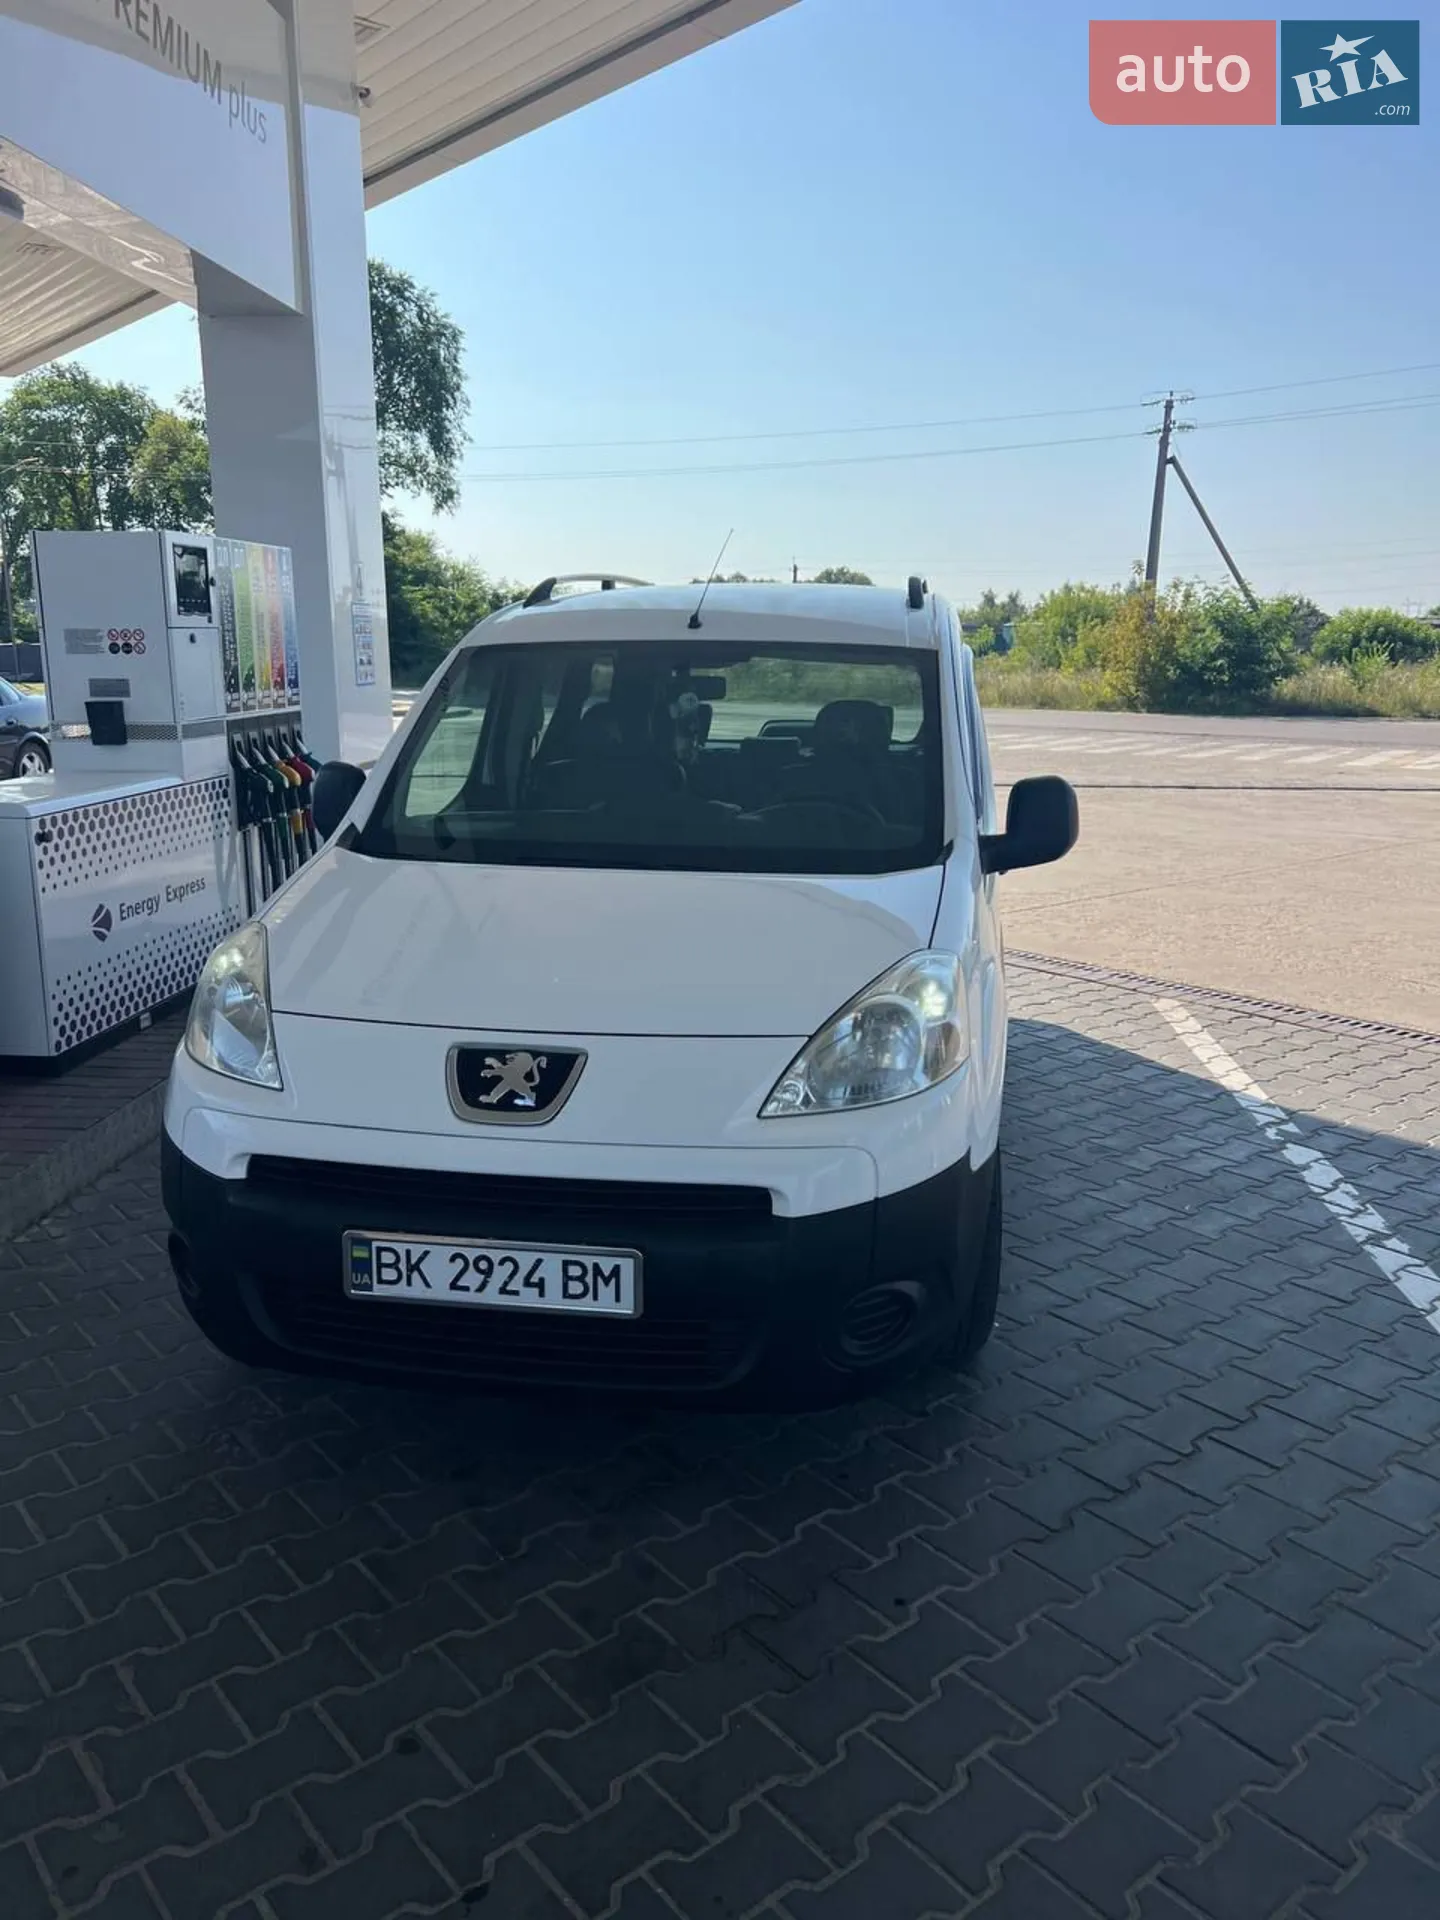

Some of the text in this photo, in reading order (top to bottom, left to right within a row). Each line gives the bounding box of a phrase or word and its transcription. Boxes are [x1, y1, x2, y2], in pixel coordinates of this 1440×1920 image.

[228, 81, 267, 144] plus
[119, 876, 206, 922] Energy Express
[352, 1272, 371, 1286] UA
[375, 1245, 622, 1303] BK 2924 BM
